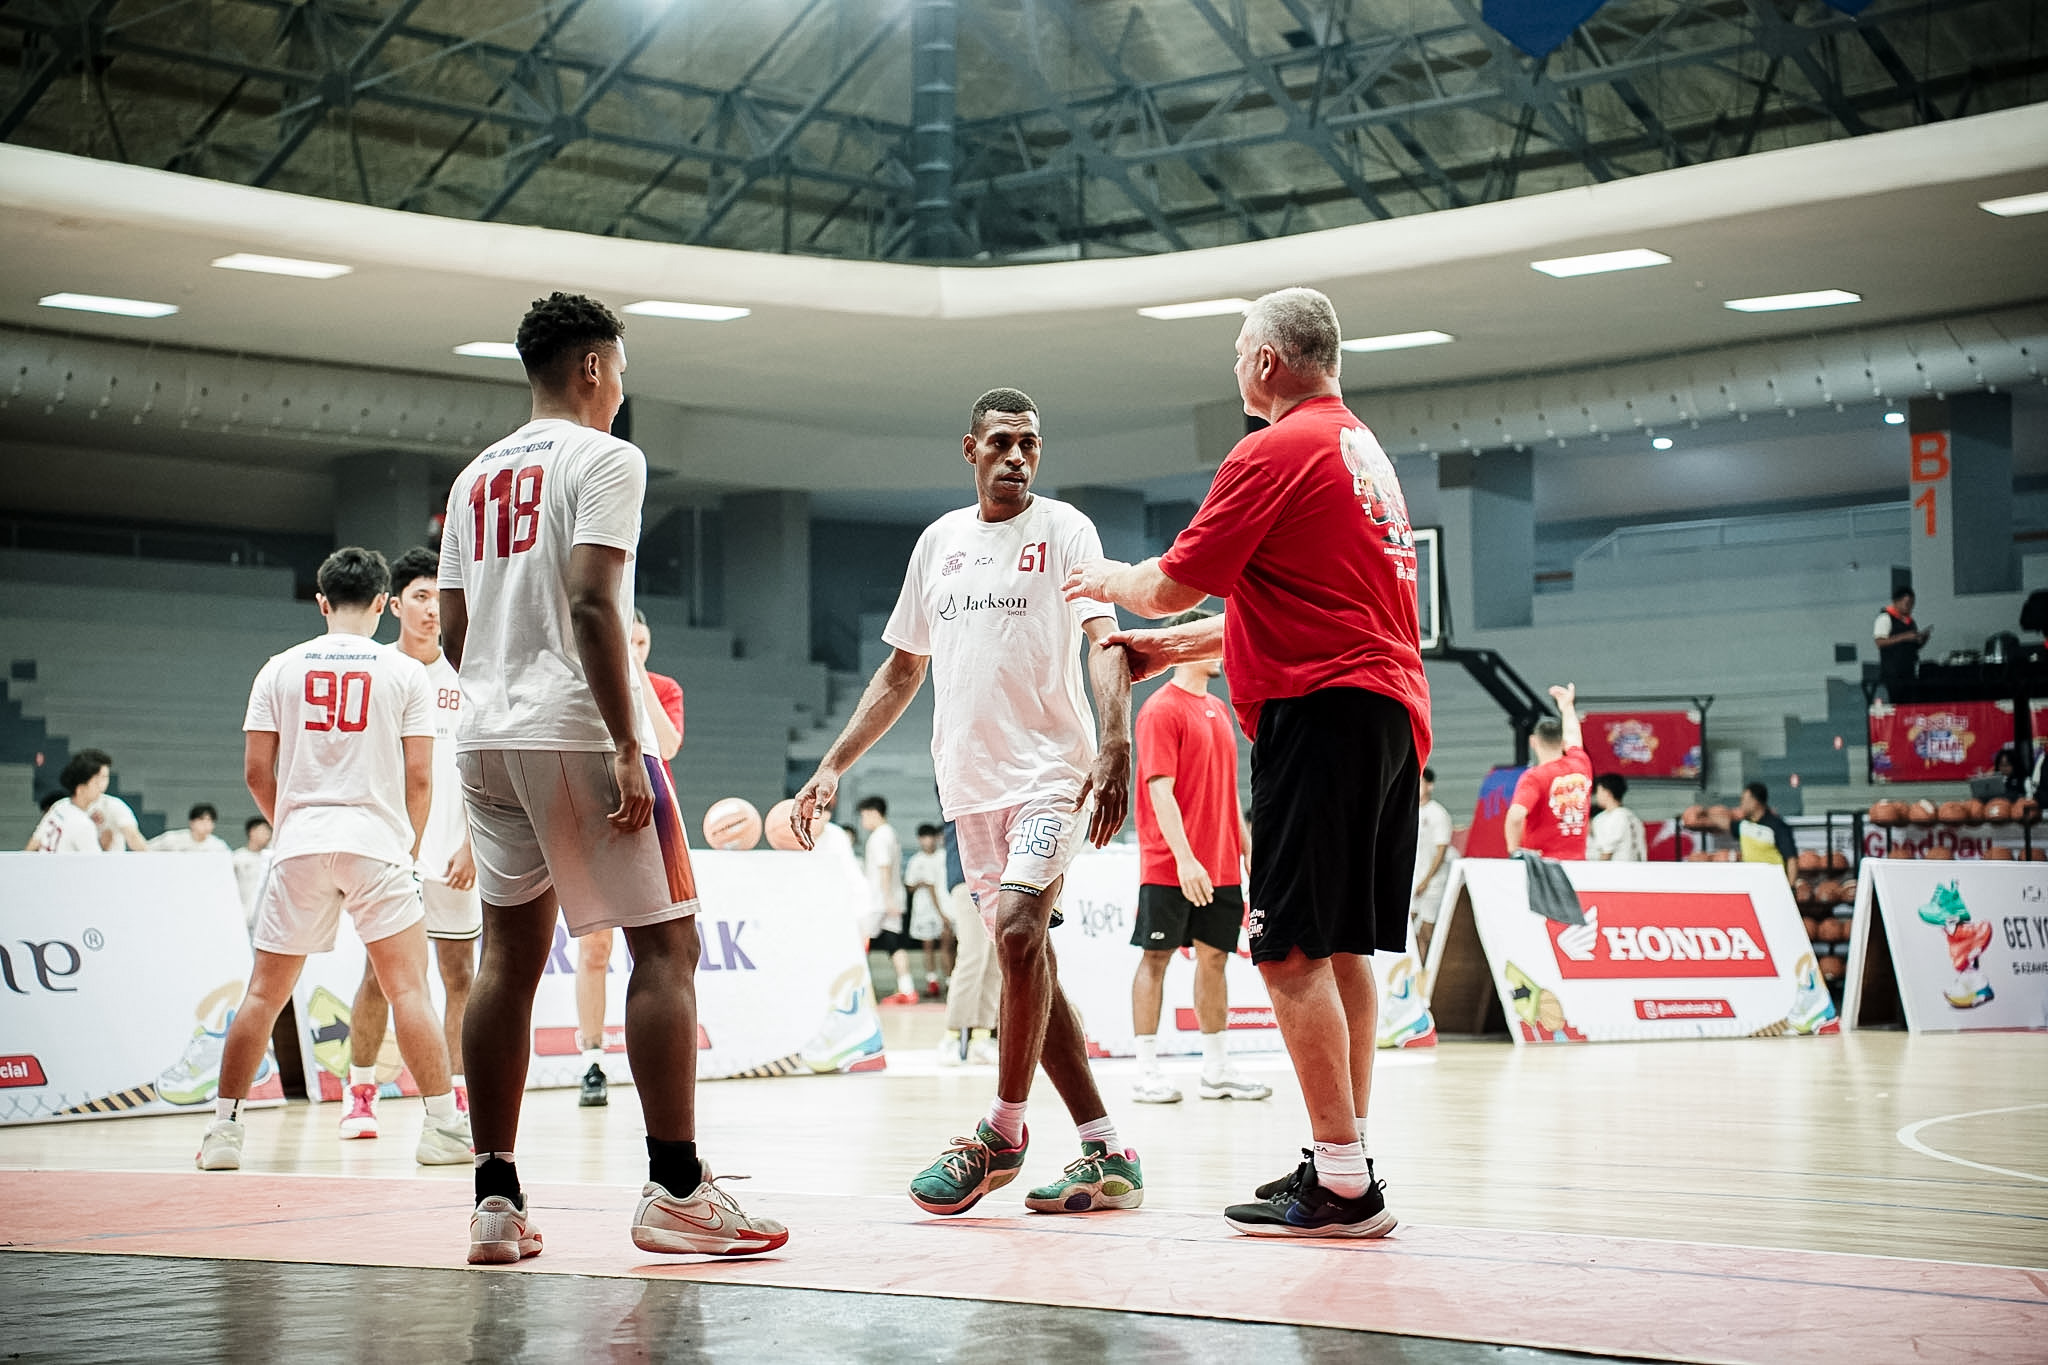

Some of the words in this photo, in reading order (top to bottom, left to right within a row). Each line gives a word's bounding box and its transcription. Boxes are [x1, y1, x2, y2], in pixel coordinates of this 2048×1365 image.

[1911, 432, 1950, 483] B
[468, 464, 544, 562] 118
[1914, 486, 1937, 538] 1
[1017, 541, 1047, 573] 61
[963, 592, 1027, 611] Jackson
[304, 669, 372, 732] 90
[437, 688, 460, 710] 88
[1014, 817, 1062, 859] 15
[1601, 925, 1766, 962] HONDA
[2003, 916, 2033, 950] GET
